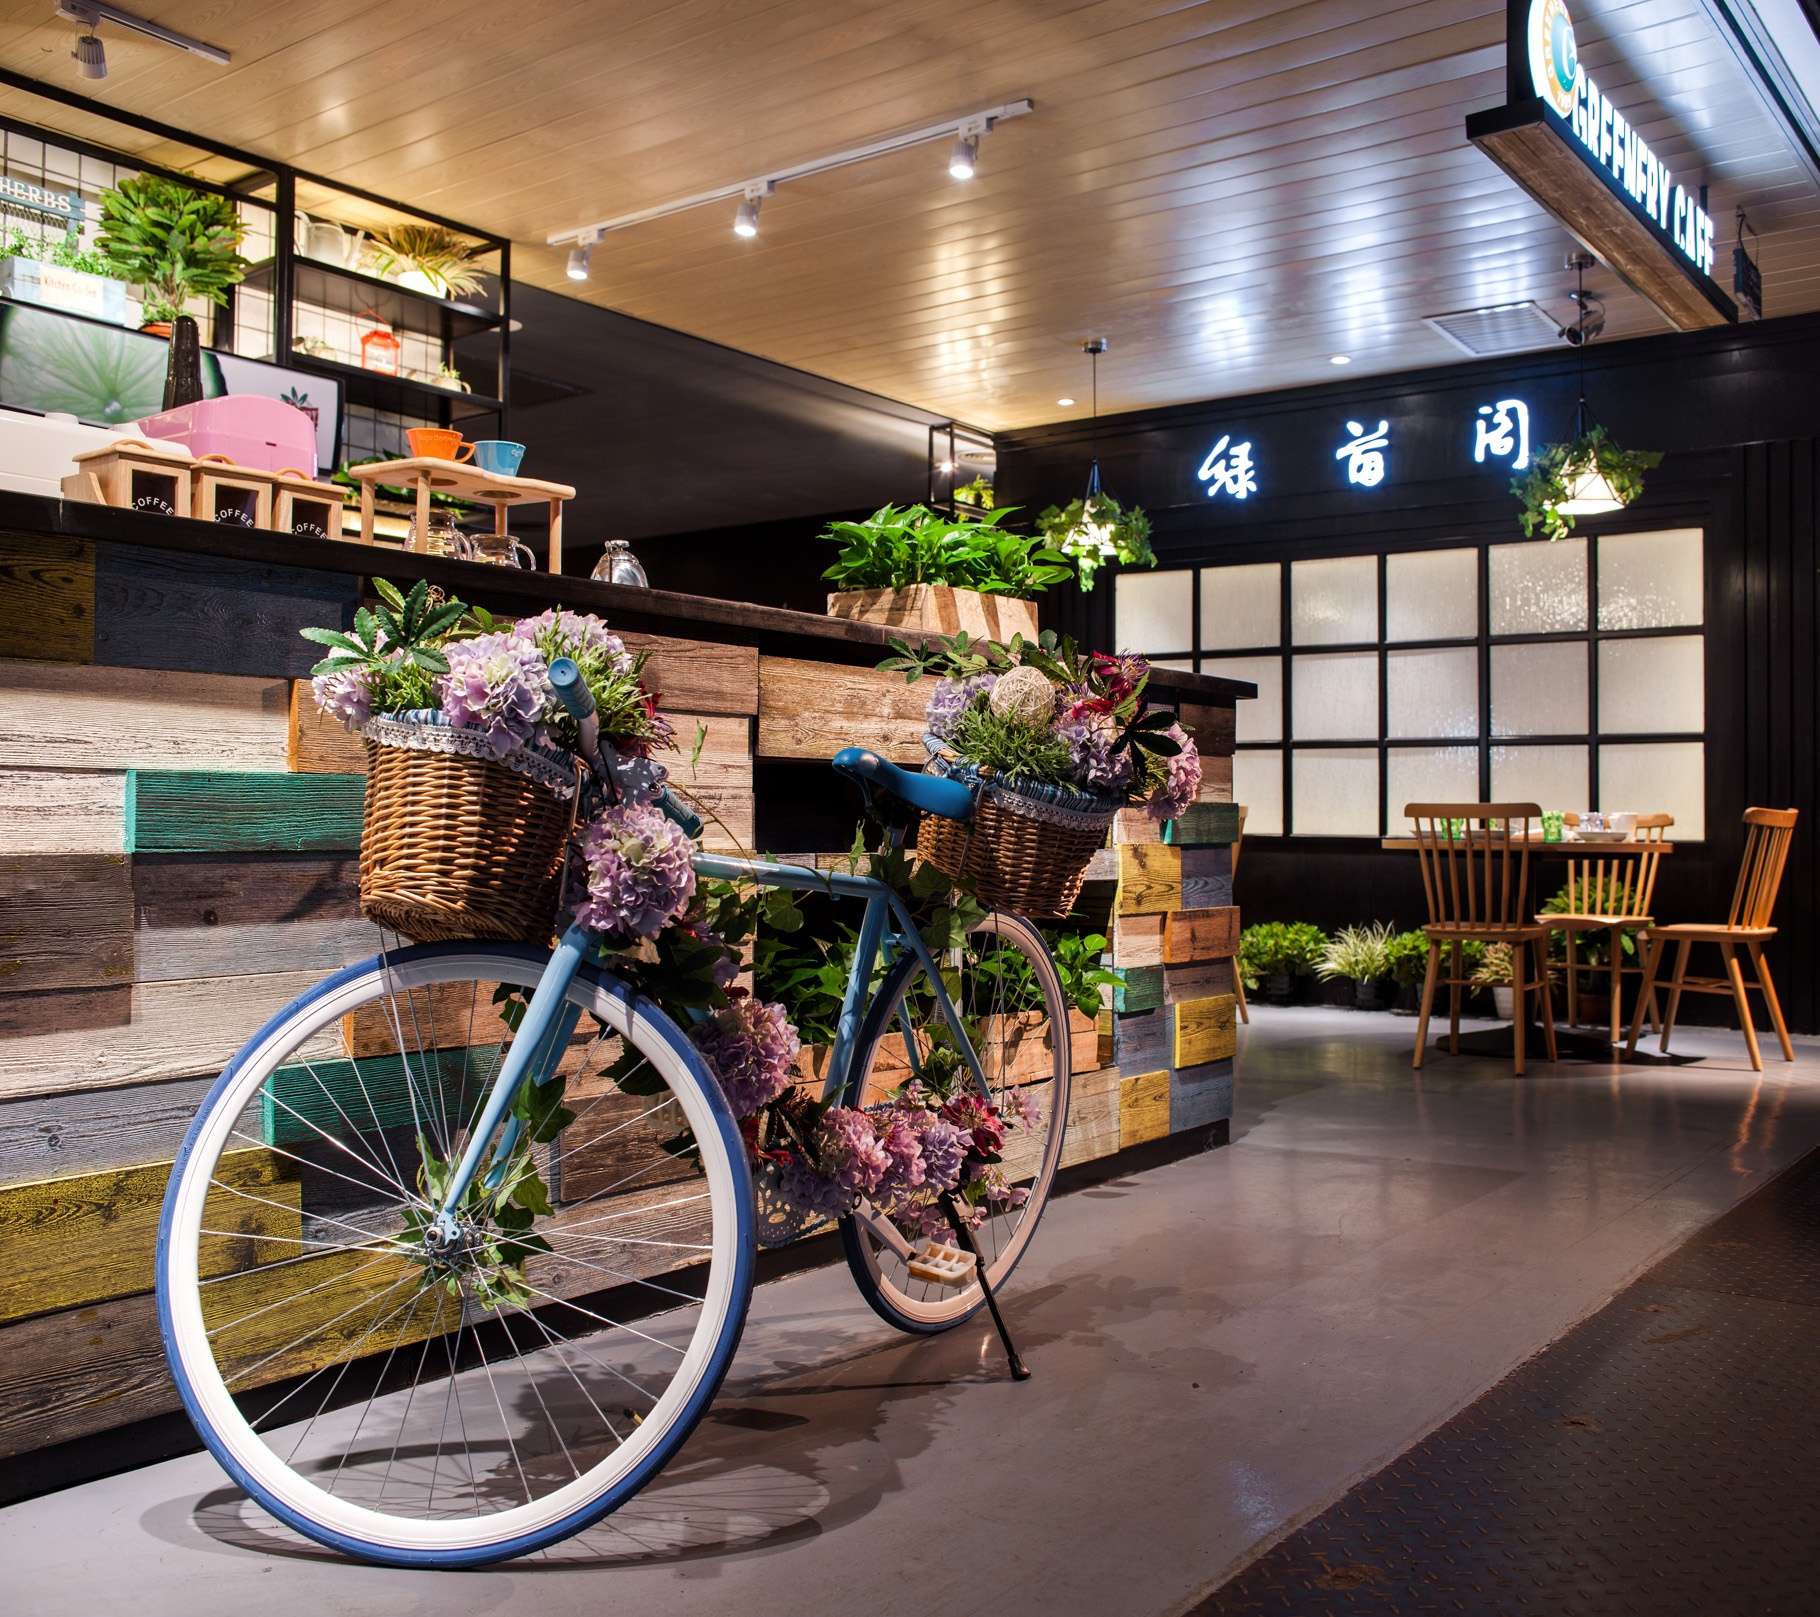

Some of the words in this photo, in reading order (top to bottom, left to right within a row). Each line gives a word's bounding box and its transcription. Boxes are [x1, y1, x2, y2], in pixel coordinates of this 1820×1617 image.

[0, 177, 72, 213] HERBS
[131, 496, 174, 516] COFFEE
[214, 508, 254, 528] COFFEE
